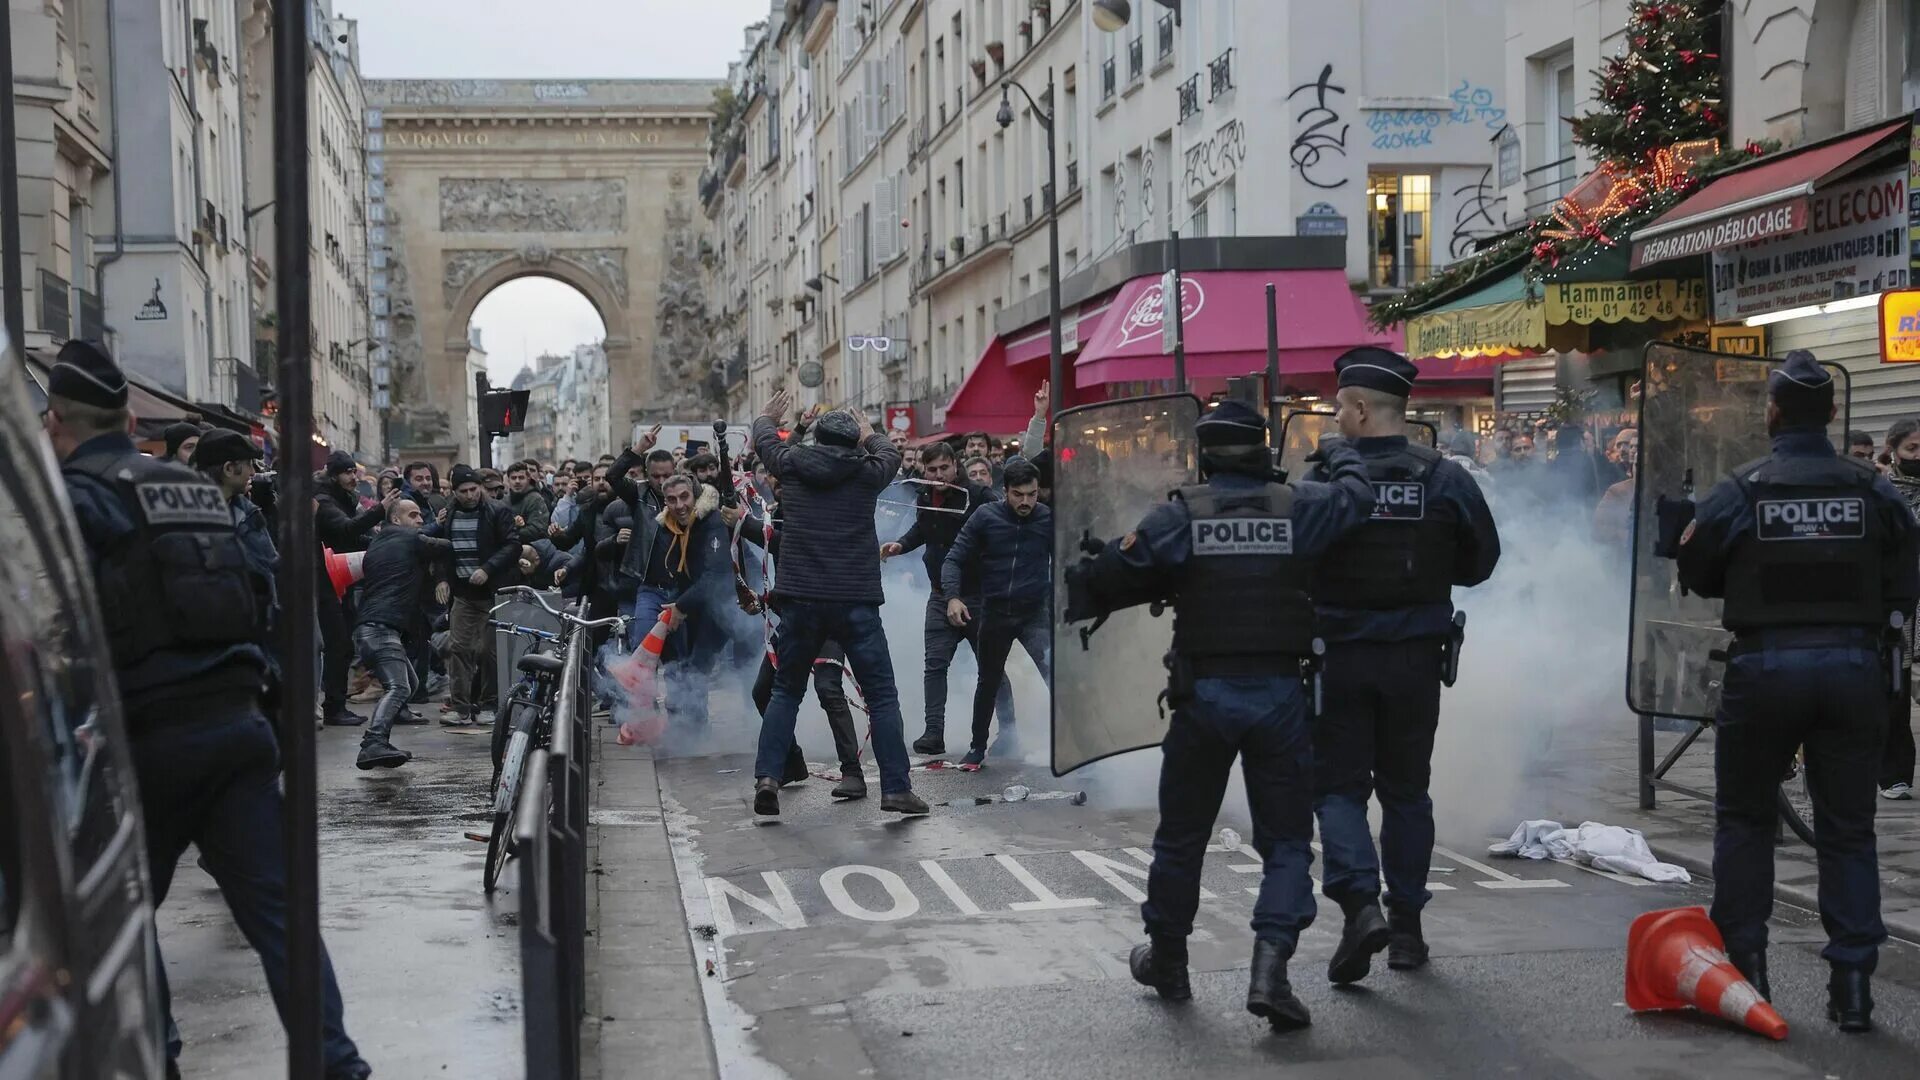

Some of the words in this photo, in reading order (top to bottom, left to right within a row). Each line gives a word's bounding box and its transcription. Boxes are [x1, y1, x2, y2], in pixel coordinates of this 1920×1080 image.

[1804, 179, 1904, 235] ELECOM
[1641, 227, 1715, 264] RÉPARATION
[1714, 206, 1792, 246] DÉBLOCAGE
[1749, 258, 1771, 280] GSM
[1773, 256, 1782, 274] &
[1784, 235, 1875, 272] INFORMATIQUES
[1816, 265, 1857, 282] TELEPHONE
[1560, 281, 1662, 303] Hammamet
[1676, 279, 1705, 298] Fle
[1567, 304, 1593, 319] Tel:
[1603, 303, 1619, 317] 01
[1629, 302, 1647, 316] 42
[1656, 301, 1673, 314] 46
[1683, 301, 1699, 314] 41
[1723, 338, 1756, 354] WU
[142, 486, 227, 512] POLICE
[1376, 485, 1419, 504] ICE
[1763, 501, 1860, 524] POLICE
[1198, 522, 1288, 543] POLICE
